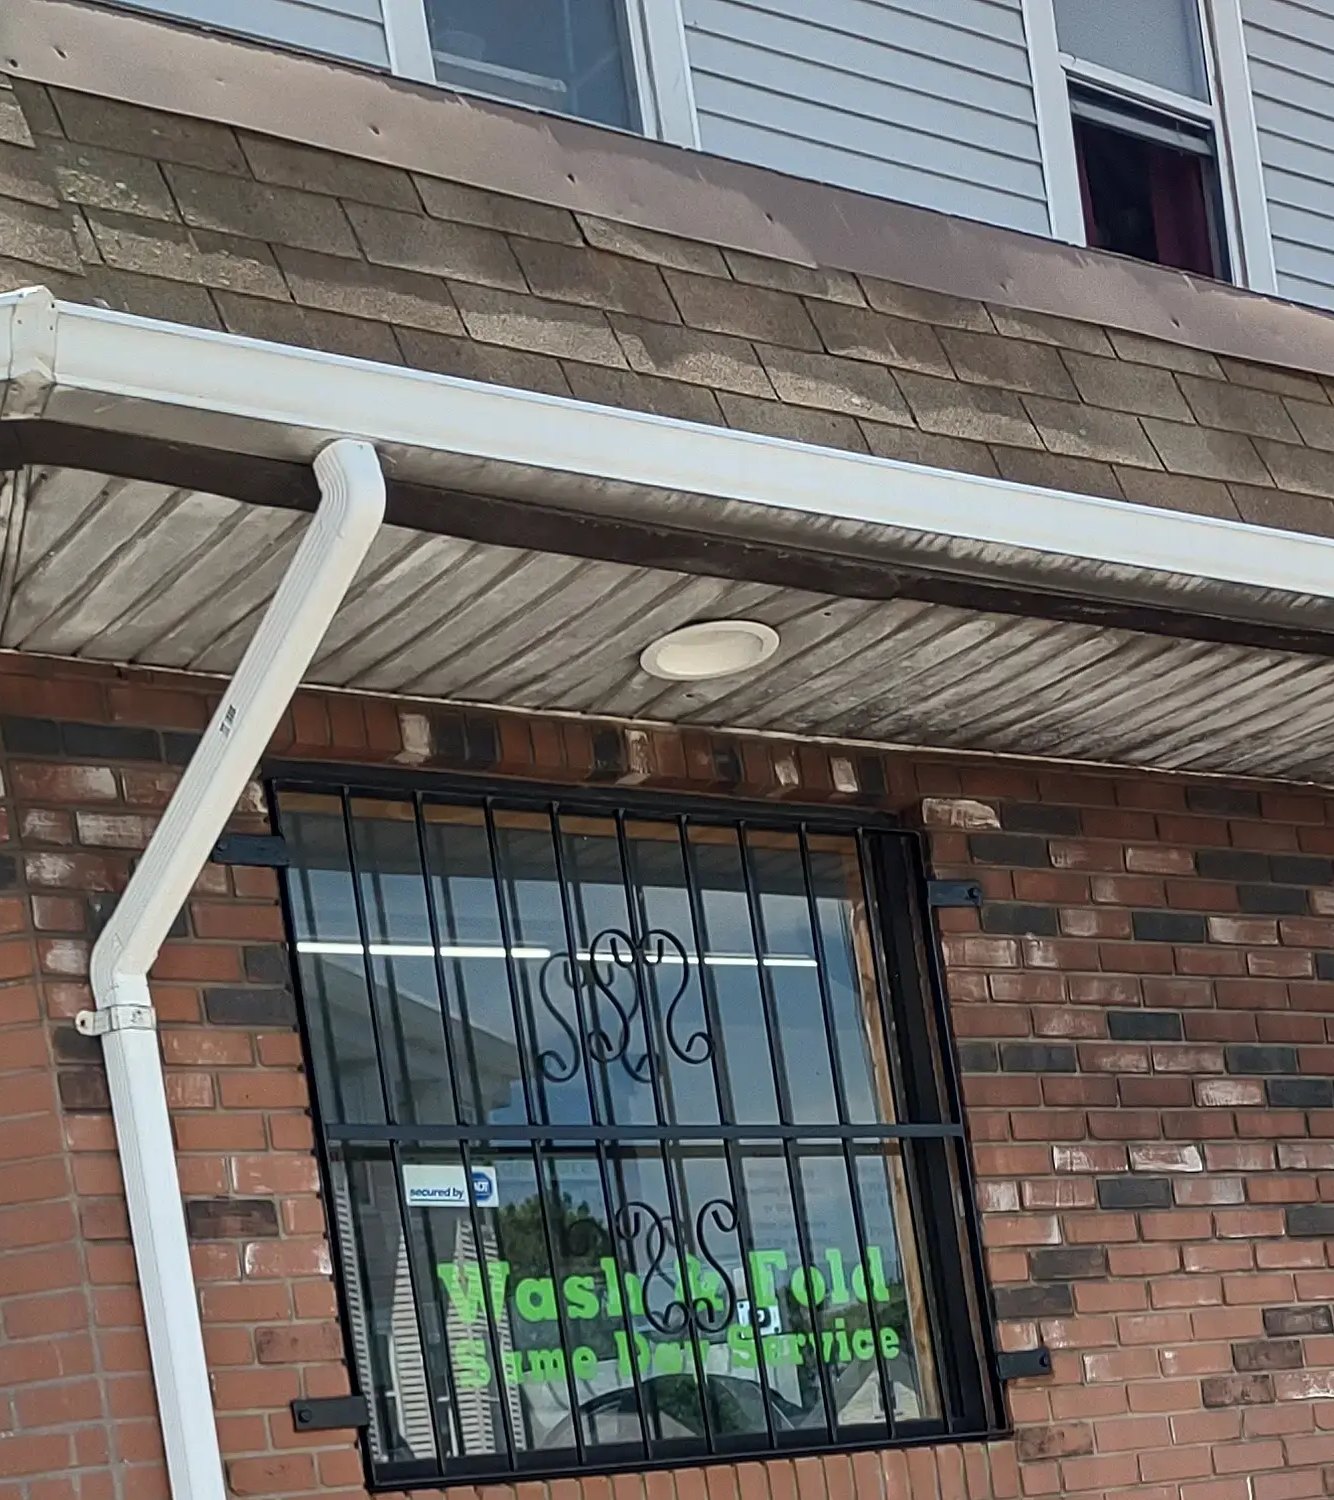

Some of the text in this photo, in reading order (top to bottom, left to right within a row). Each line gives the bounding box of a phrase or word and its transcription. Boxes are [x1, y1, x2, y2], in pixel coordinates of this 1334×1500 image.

[410, 1187, 464, 1199] secured by
[437, 1256, 644, 1324] Wash
[748, 1246, 890, 1308] Fold
[454, 1339, 598, 1388] Same
[727, 1317, 899, 1368] Service
